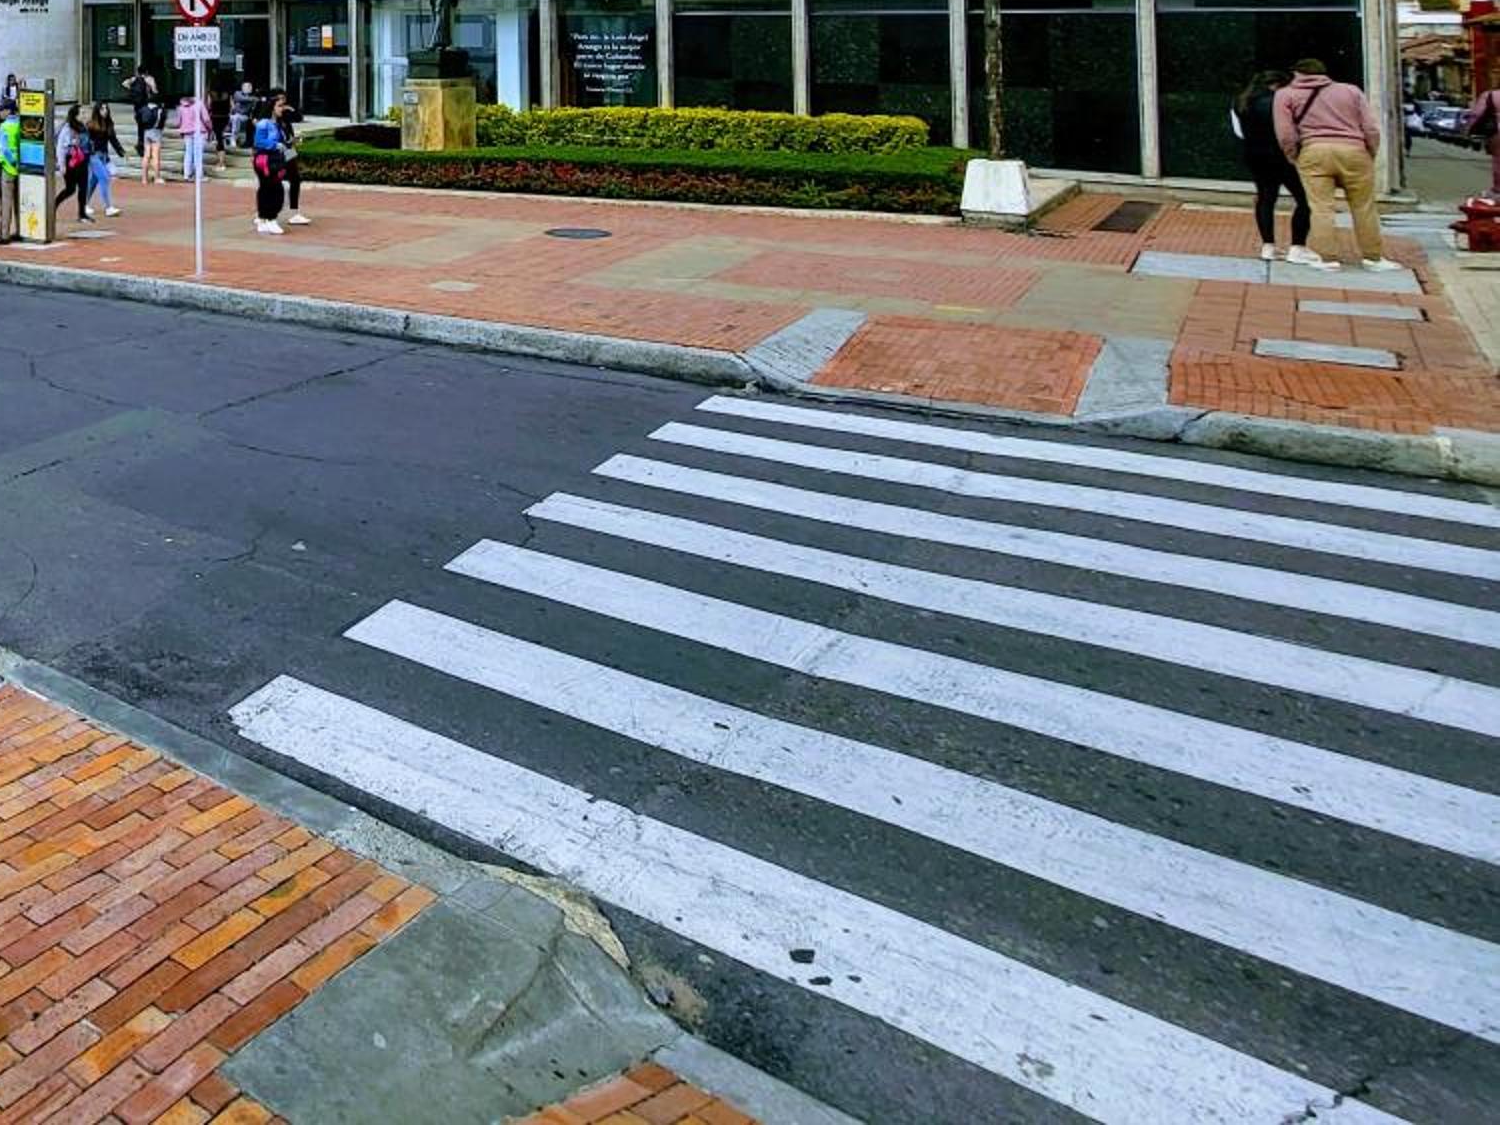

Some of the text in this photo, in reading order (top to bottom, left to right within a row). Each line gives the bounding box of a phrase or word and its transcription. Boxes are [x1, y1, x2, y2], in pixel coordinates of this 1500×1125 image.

[178, 33, 217, 41] EN AMBOS
[178, 44, 219, 53] COSTADOS
